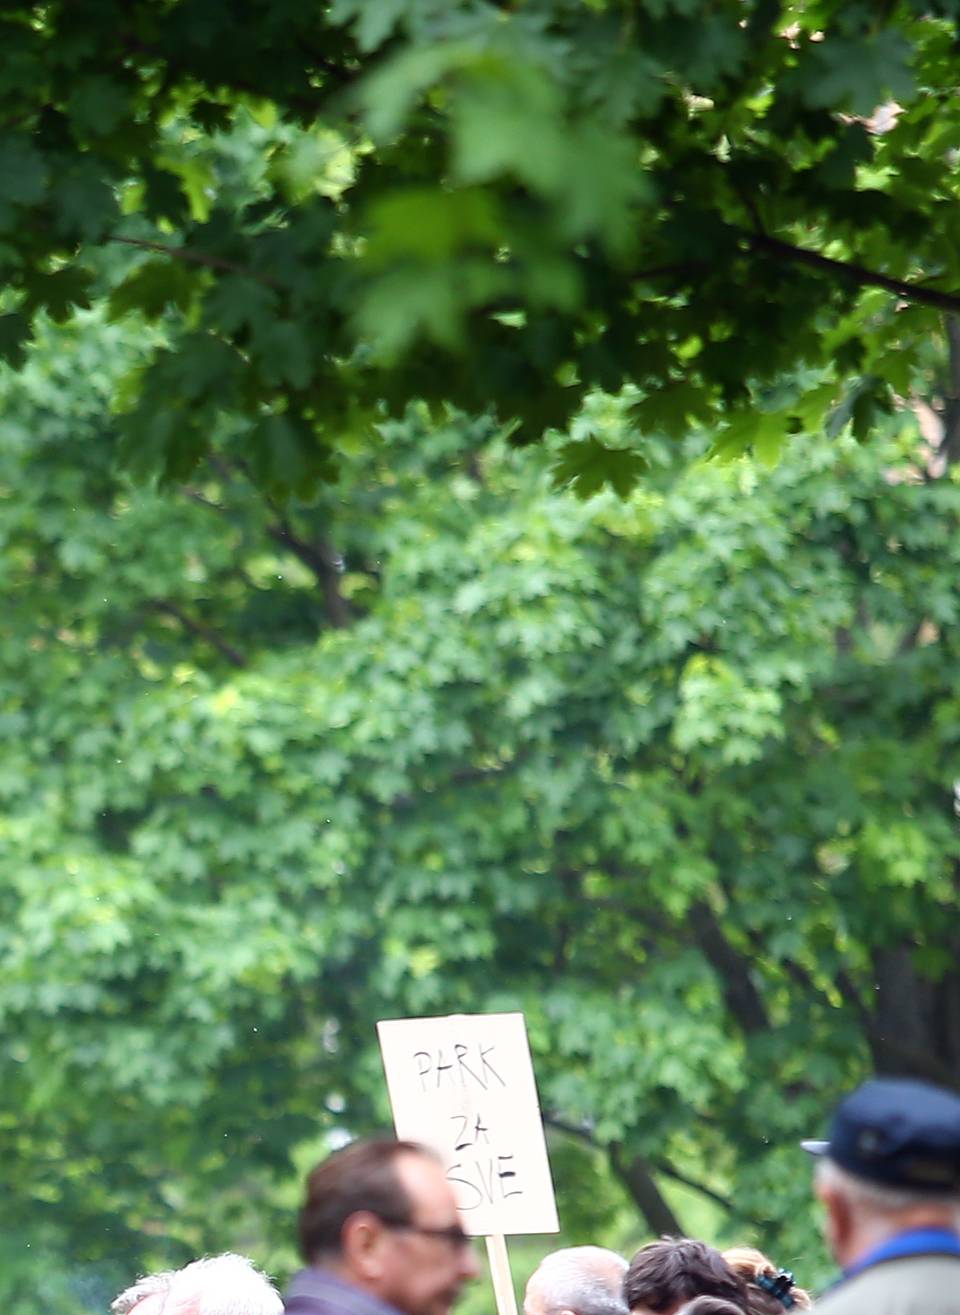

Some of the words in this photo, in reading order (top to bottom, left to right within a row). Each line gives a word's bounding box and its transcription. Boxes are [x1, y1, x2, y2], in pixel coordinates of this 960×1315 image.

[413, 1043, 507, 1092] PARK
[450, 1113, 490, 1151] ZA
[445, 1154, 523, 1211] SVE
